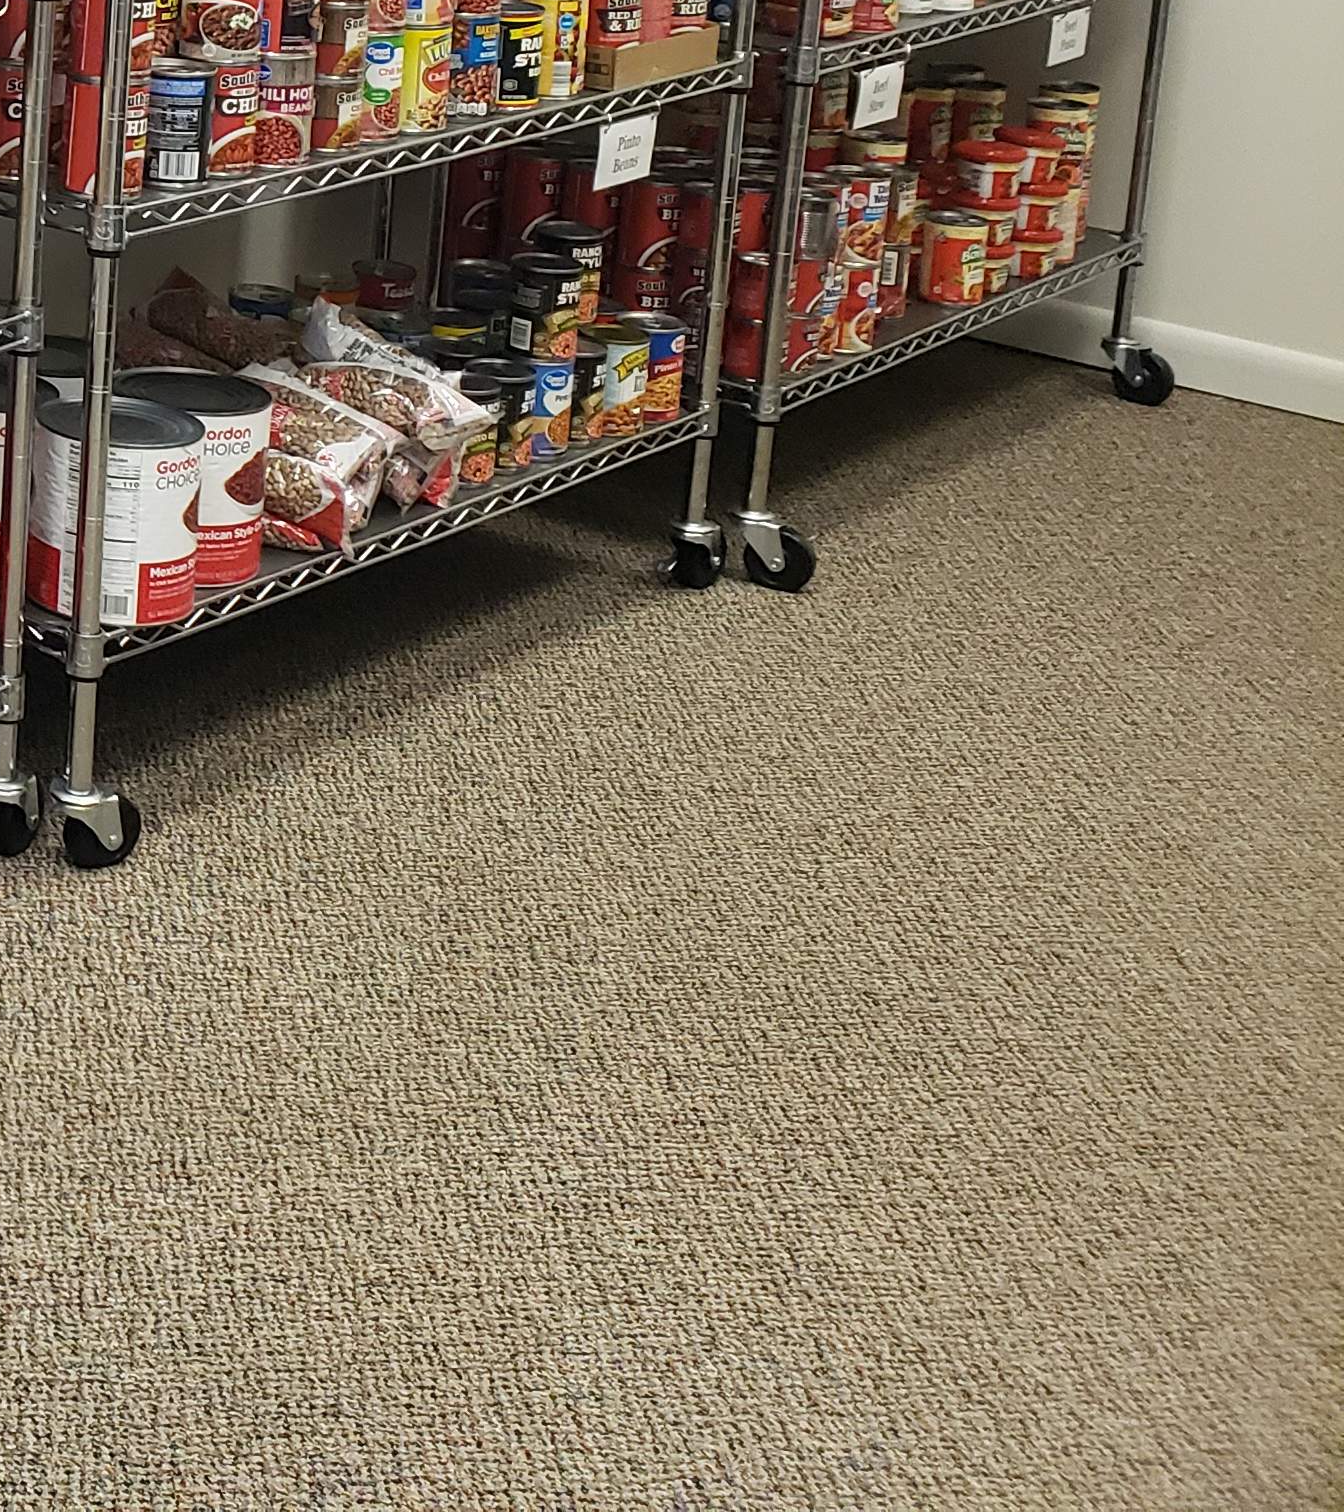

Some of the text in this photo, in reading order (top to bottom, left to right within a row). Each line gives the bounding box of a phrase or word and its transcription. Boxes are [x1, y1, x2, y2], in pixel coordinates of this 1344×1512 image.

[617, 134, 641, 152] Pinto
[612, 155, 639, 174] Beans
[150, 561, 187, 579] Mexican
